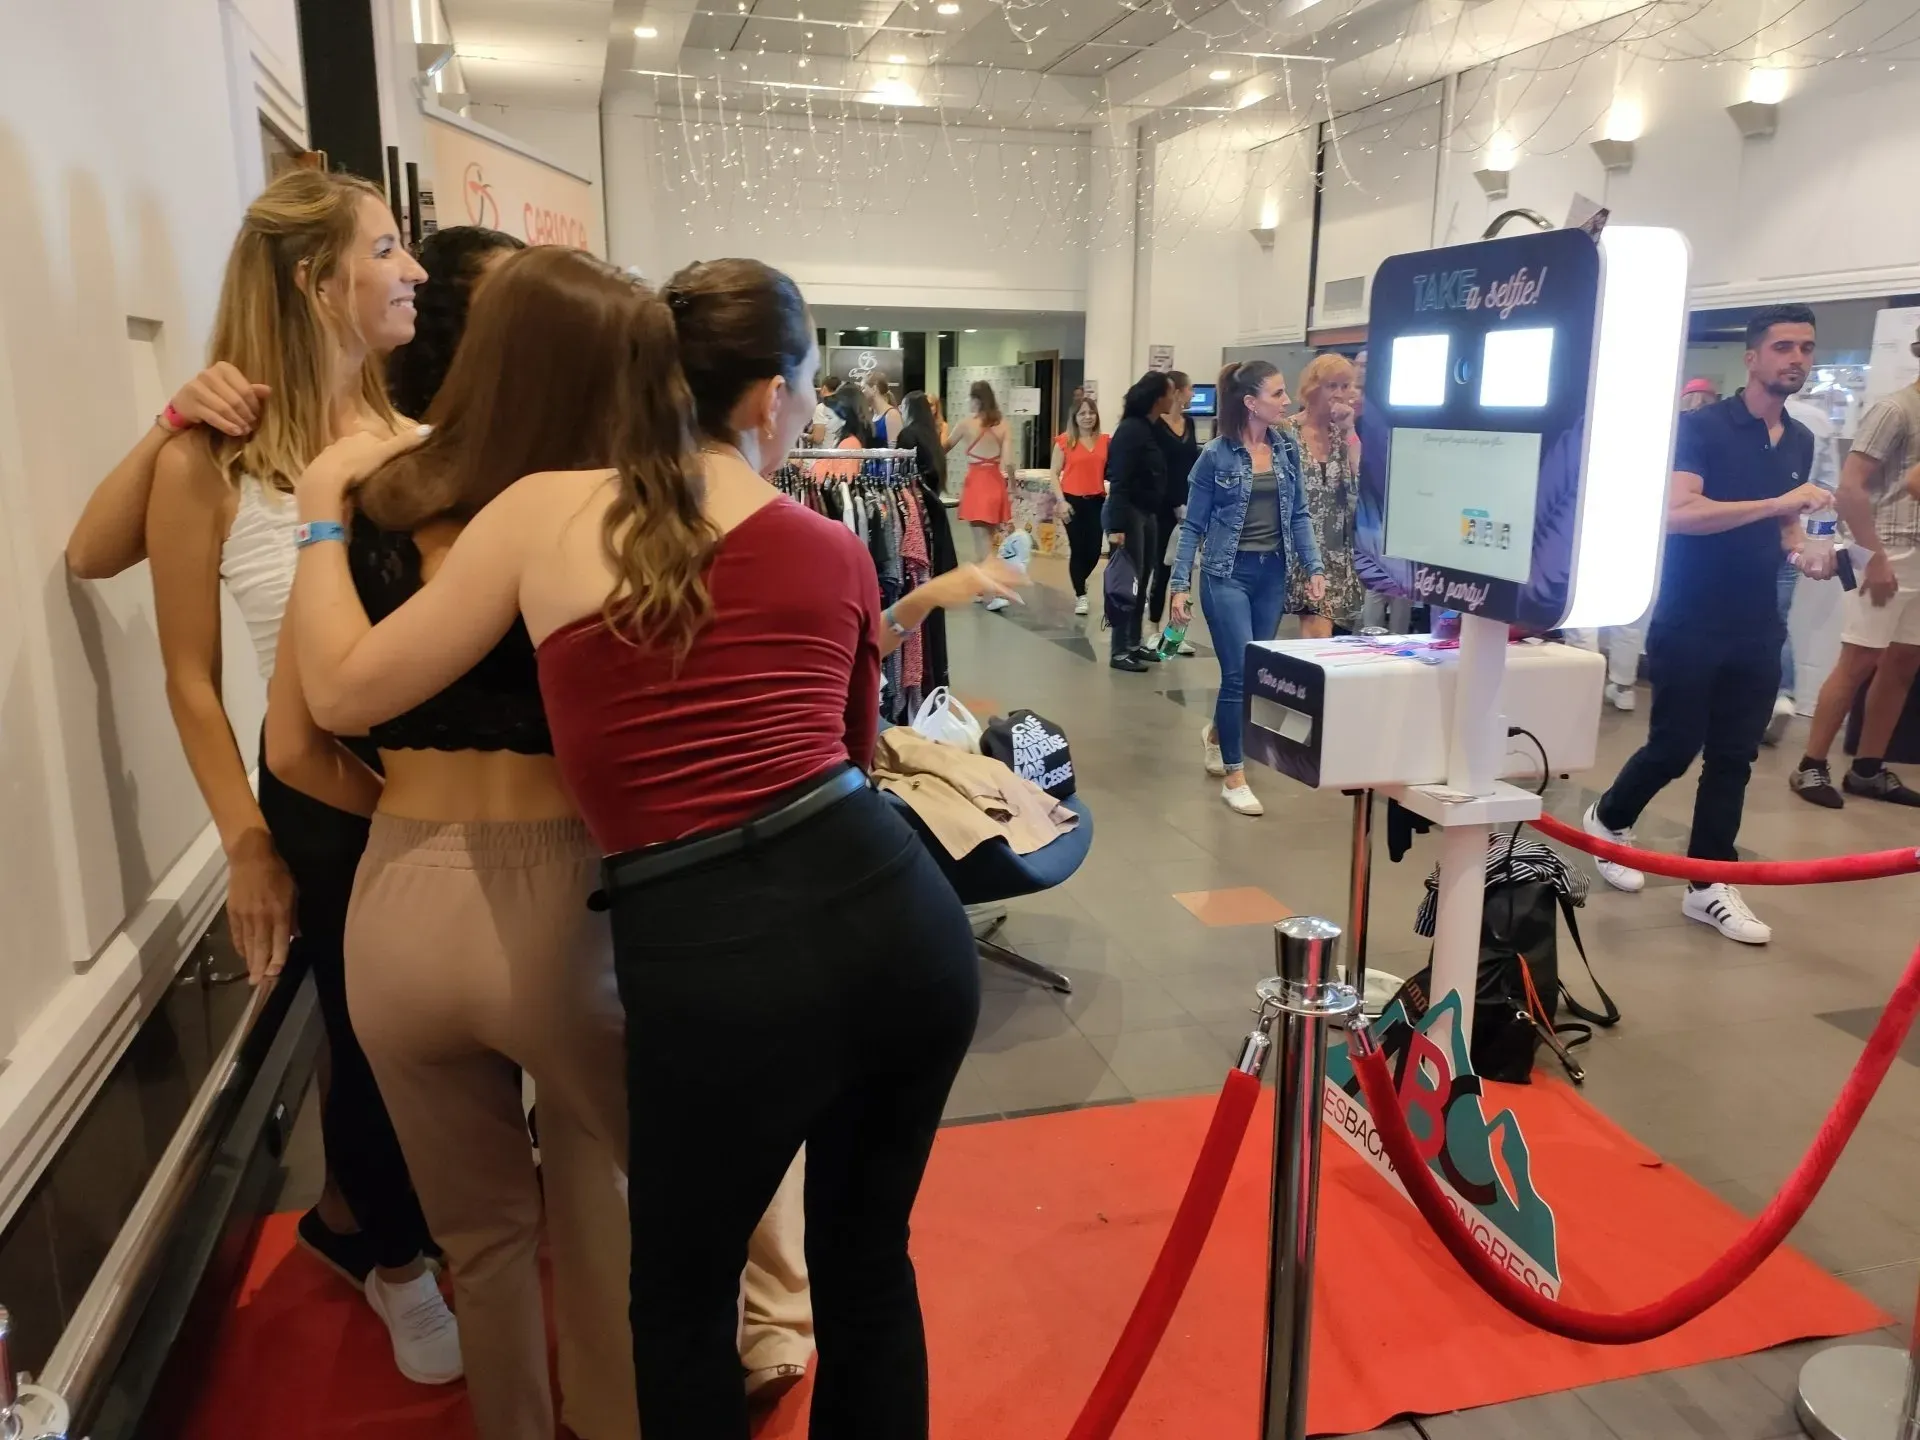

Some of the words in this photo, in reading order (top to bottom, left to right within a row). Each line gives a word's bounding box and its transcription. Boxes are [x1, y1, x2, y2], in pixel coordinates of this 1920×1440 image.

[1413, 268, 1478, 312] TAKE
[1465, 286, 1483, 310] a
[1484, 266, 1548, 320] selfie!
[1414, 567, 1444, 597] Let's
[1443, 581, 1491, 611] party!
